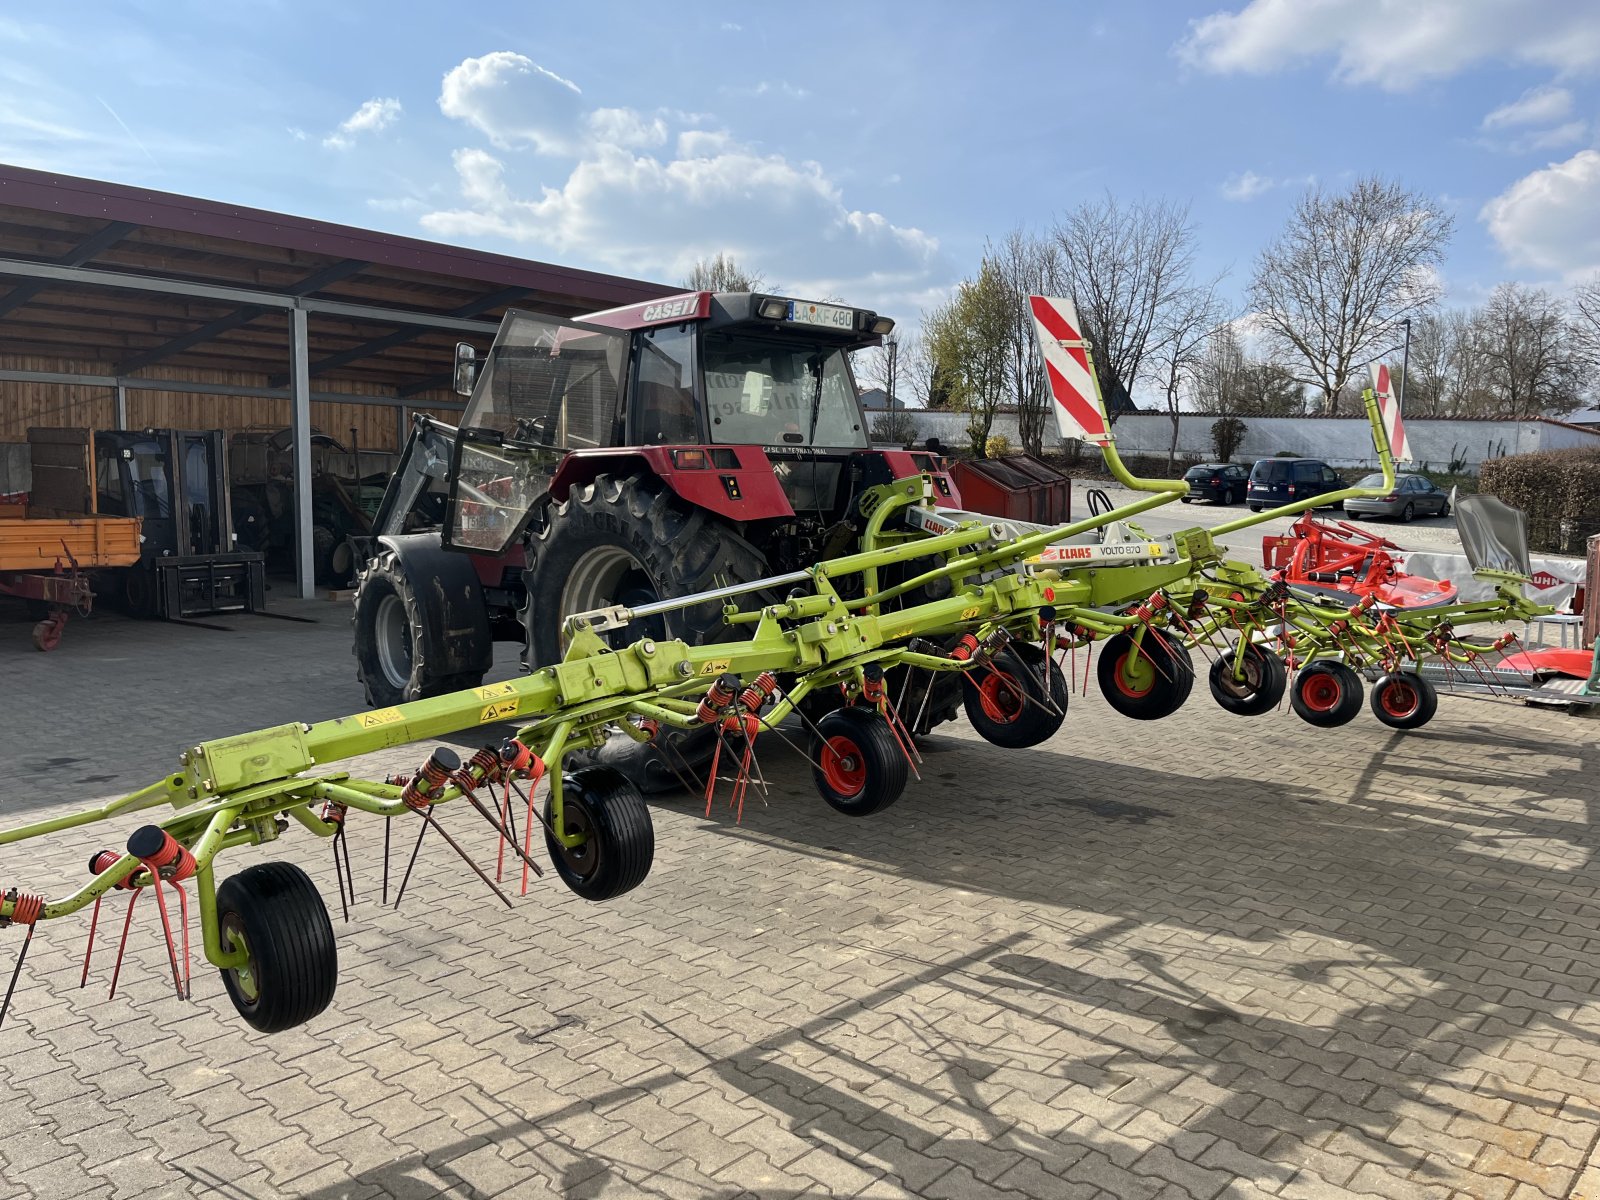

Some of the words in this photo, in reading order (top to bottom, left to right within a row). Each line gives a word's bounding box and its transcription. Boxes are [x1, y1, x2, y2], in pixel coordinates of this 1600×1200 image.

[1059, 547, 1092, 560] CLAAS
[1100, 545, 1125, 556] VOLTO
[1125, 545, 1141, 555] 870
[1532, 576, 1560, 586] UHN
